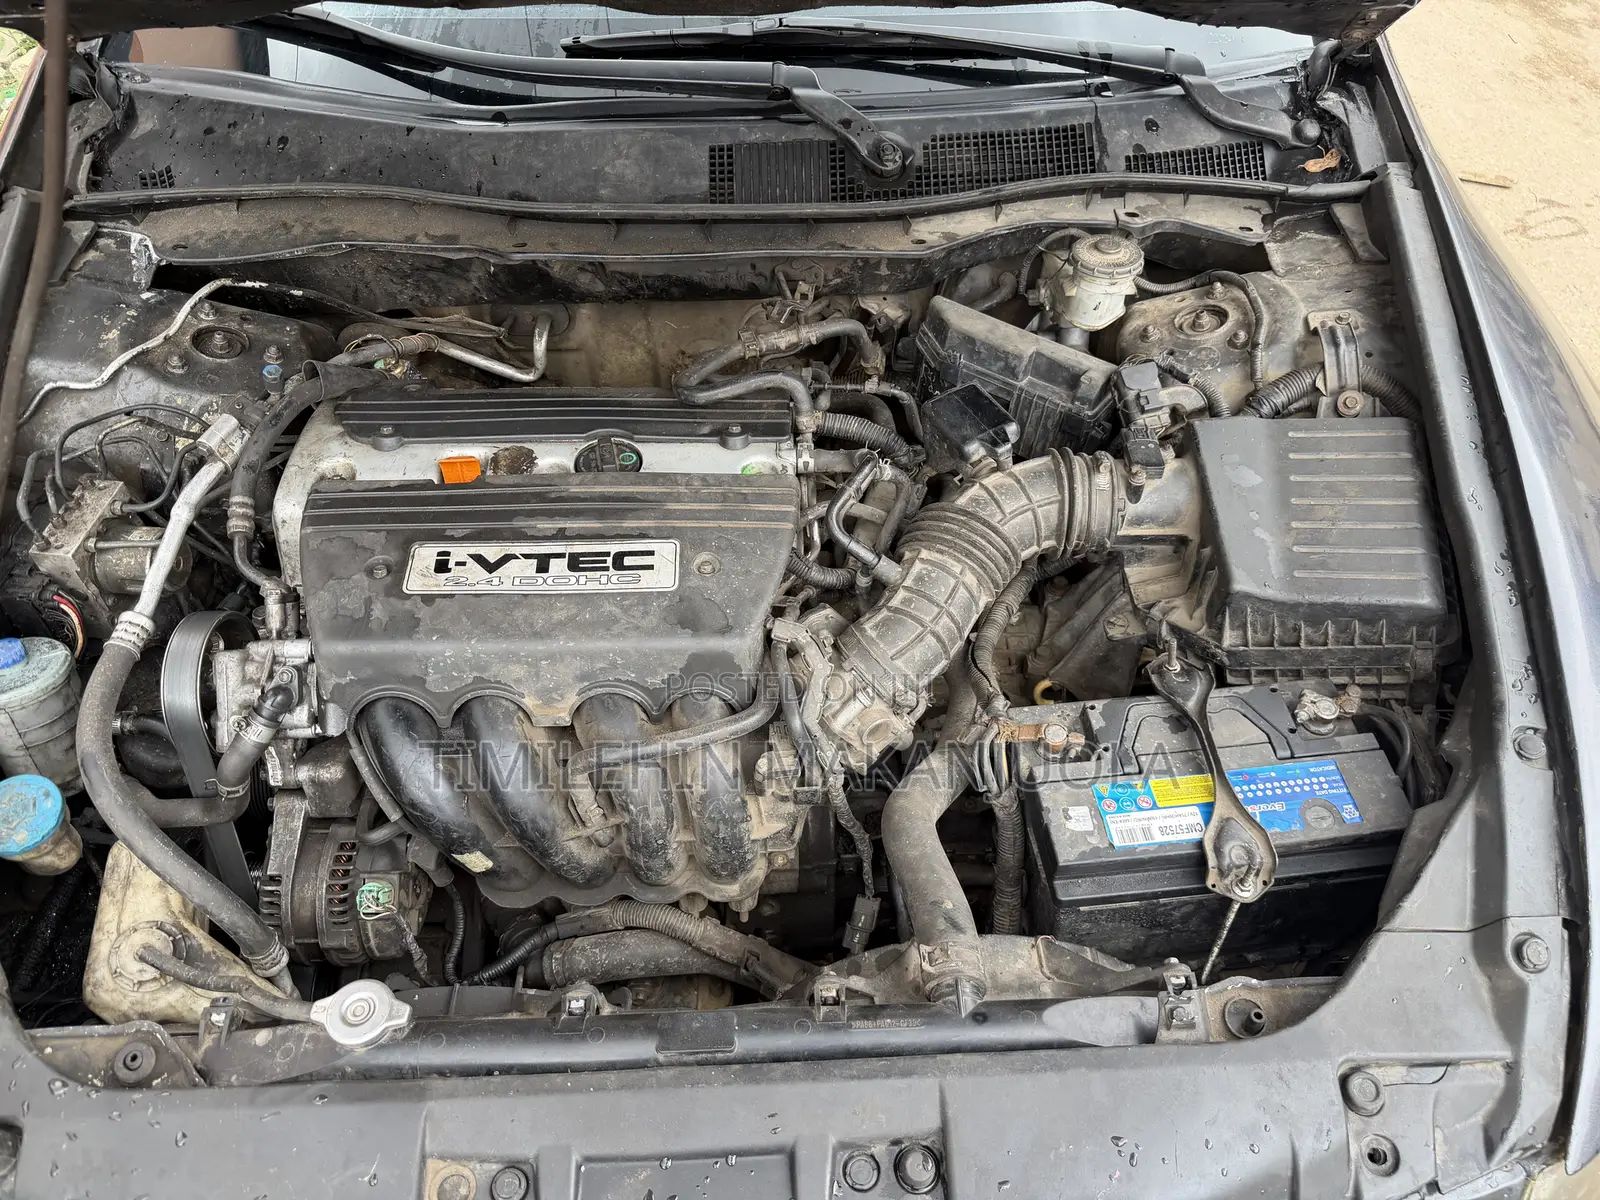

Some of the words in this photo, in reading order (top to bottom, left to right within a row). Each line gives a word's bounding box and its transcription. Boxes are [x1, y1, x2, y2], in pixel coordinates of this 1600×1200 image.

[433, 549, 656, 575] i-VTEC
[443, 575, 504, 587] 2.4
[511, 573, 642, 587] DOHC
[1158, 822, 1204, 837] CMF57528
